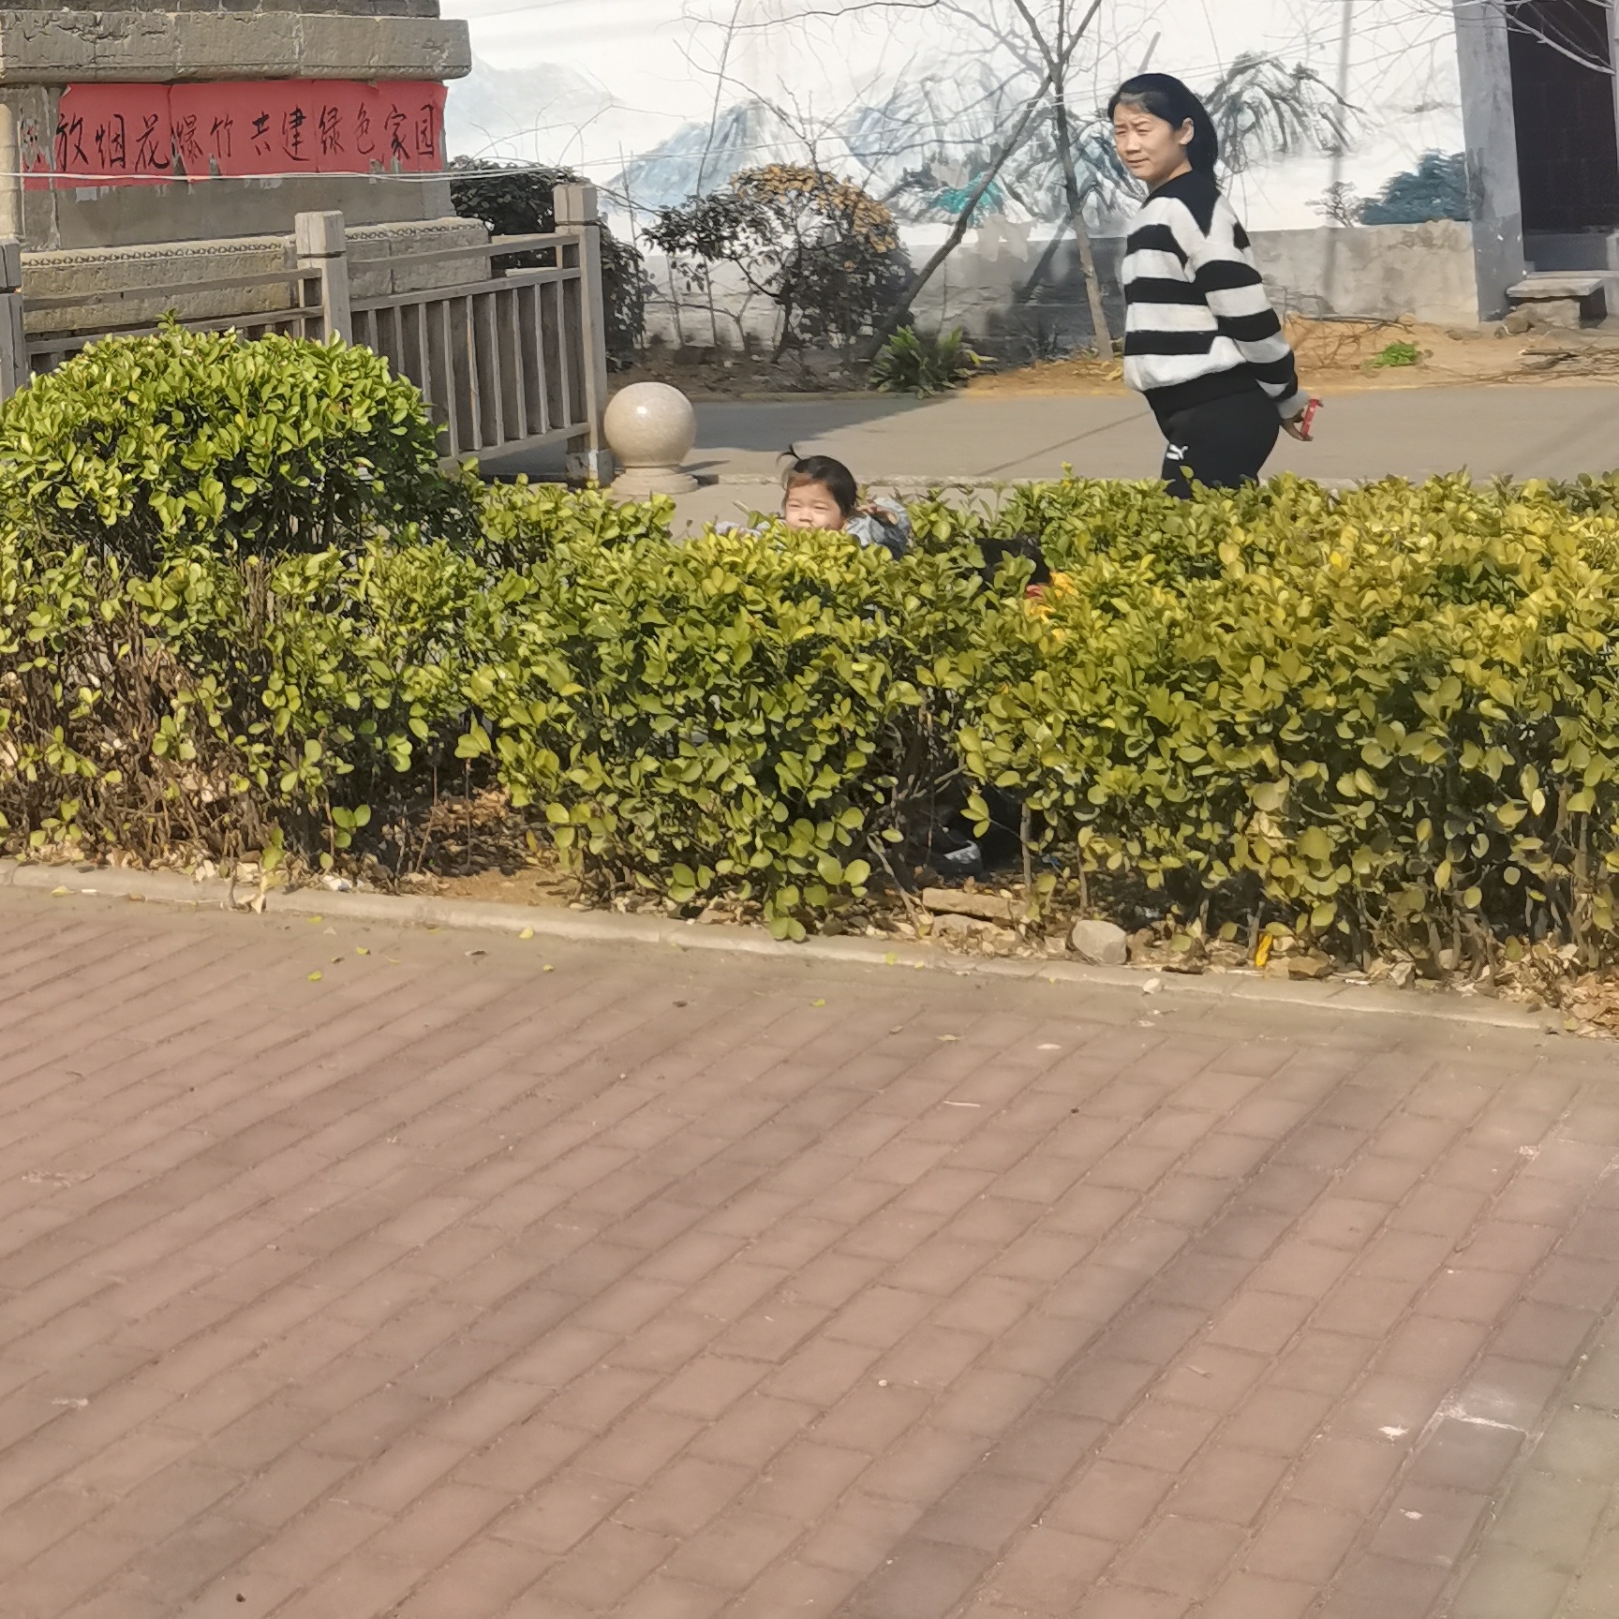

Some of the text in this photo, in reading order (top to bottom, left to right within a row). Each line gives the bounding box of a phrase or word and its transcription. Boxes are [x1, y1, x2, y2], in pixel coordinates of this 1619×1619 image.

[19, 103, 435, 172] 放烟花爆竹共建绿色家园
